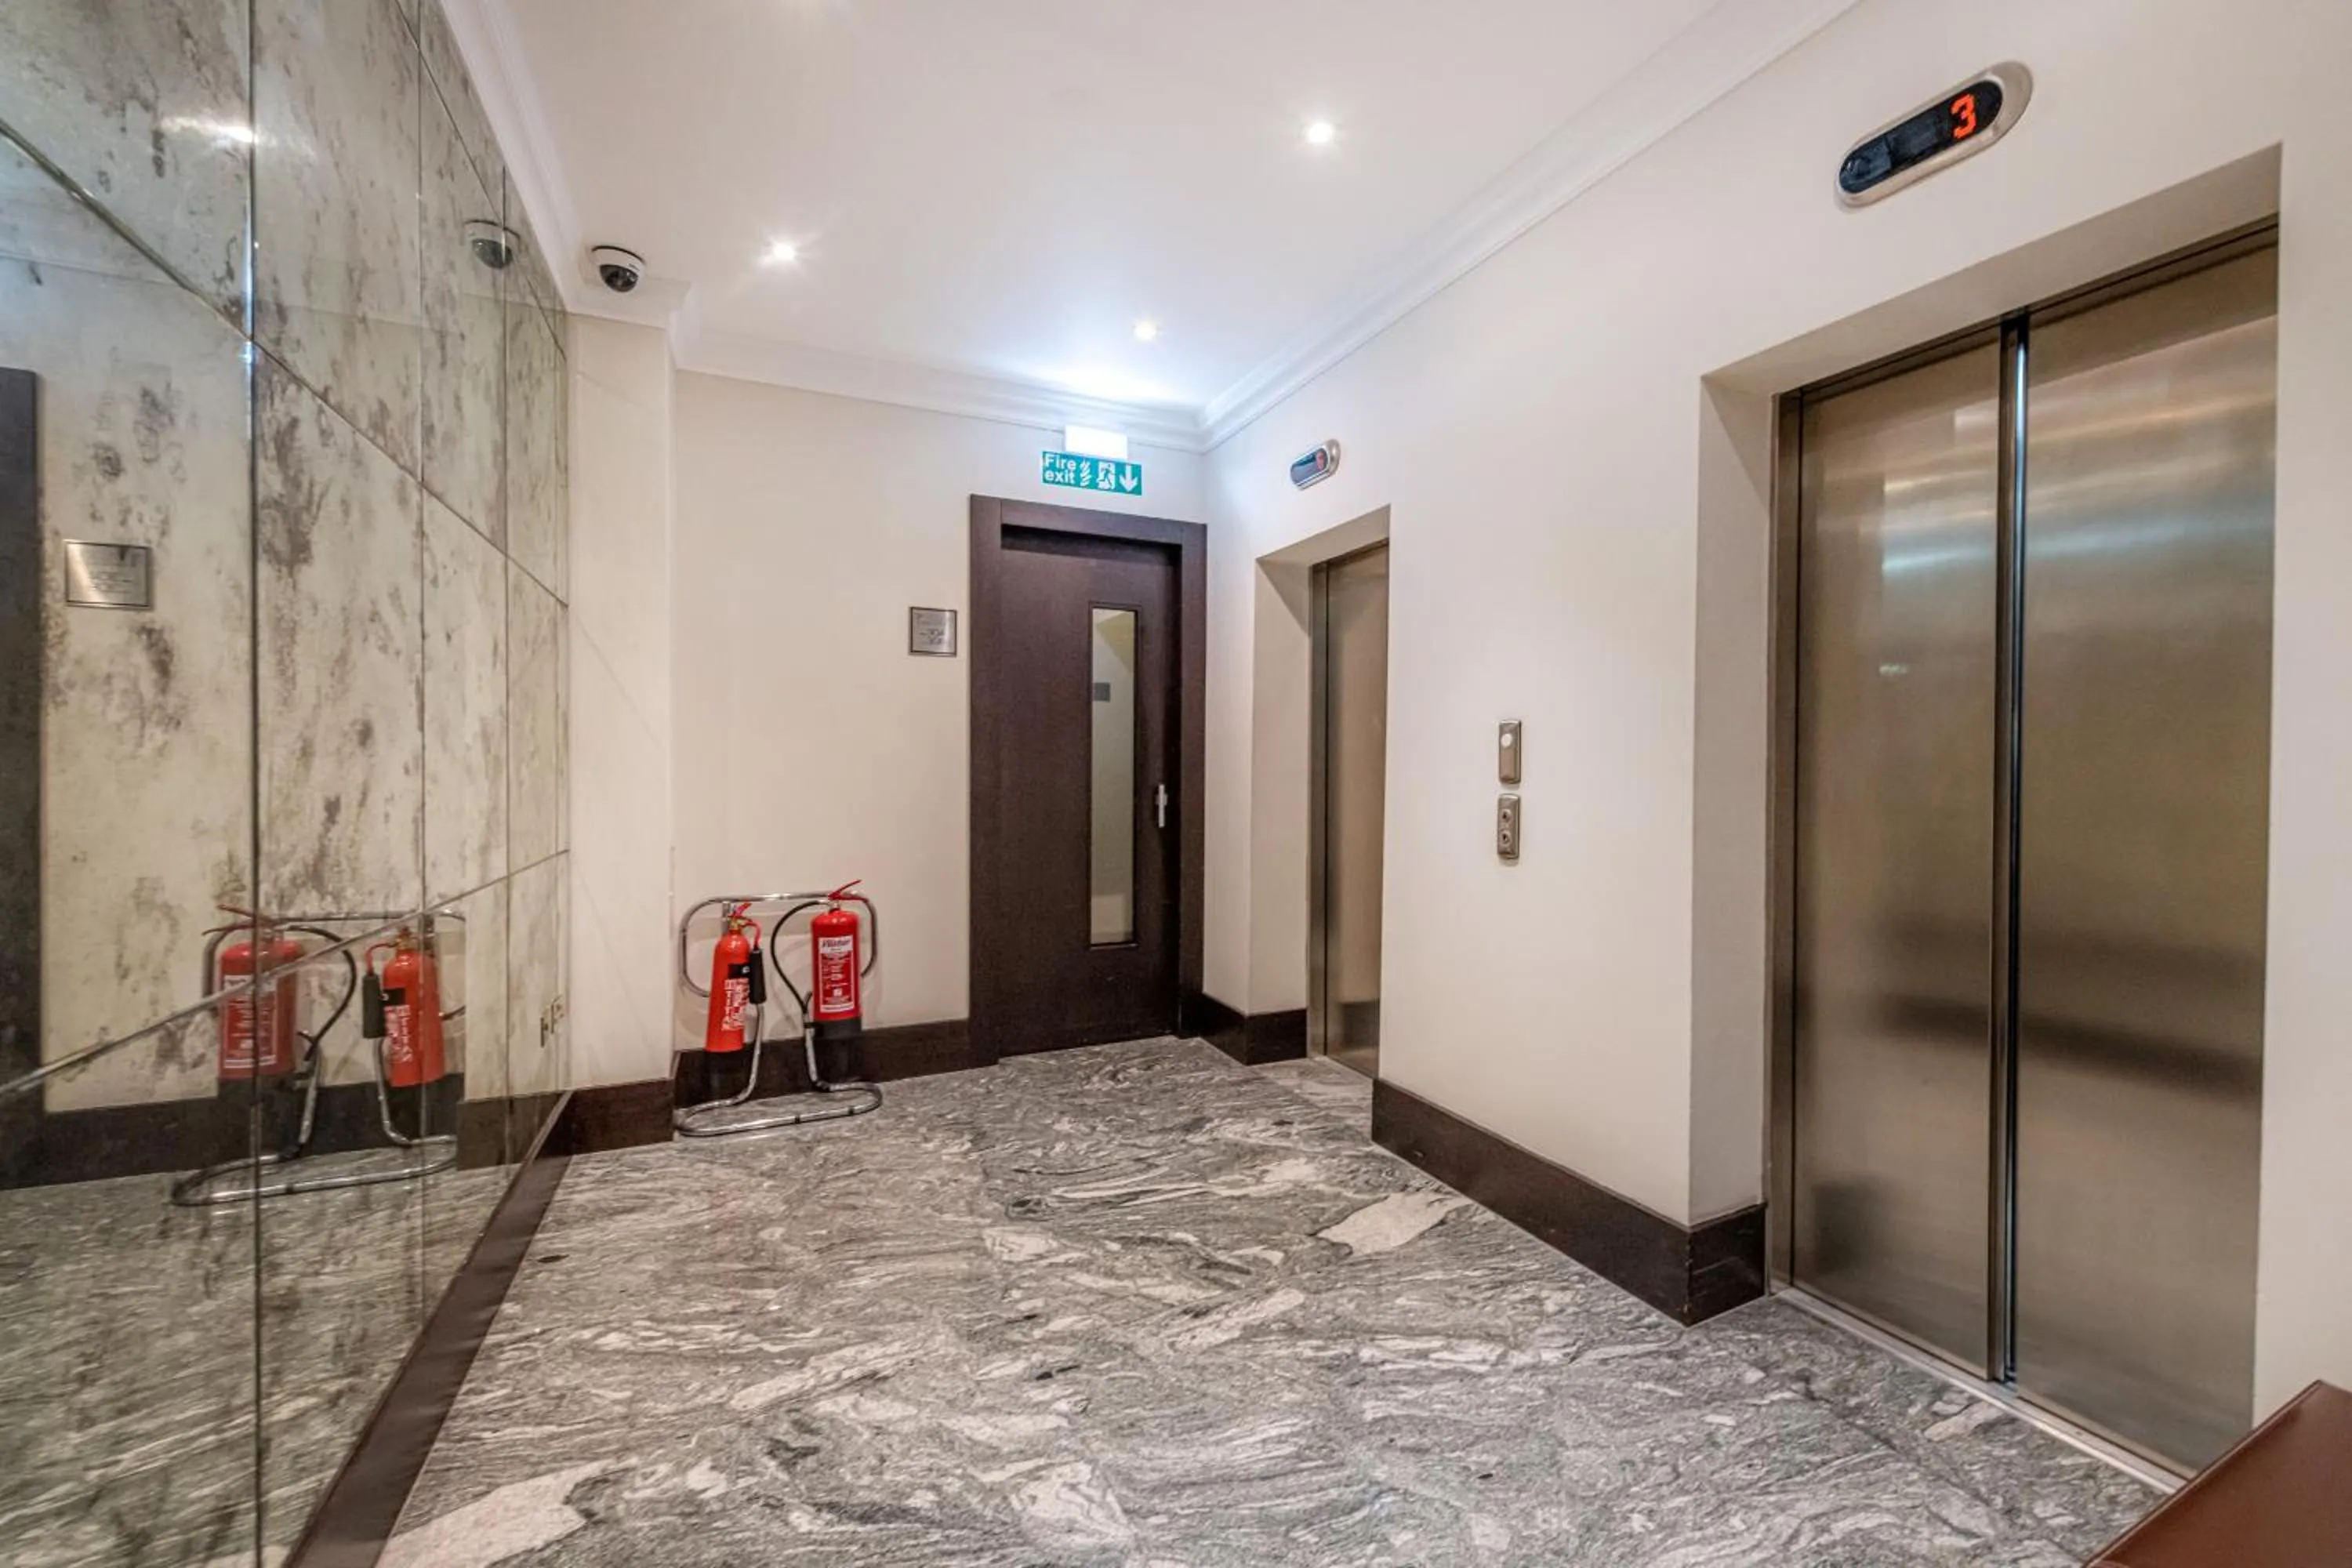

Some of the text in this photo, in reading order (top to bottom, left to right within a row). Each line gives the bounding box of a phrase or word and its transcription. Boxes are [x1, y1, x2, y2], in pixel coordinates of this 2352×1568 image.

[1951, 93, 1976, 139] 3
[1045, 453, 1076, 470] Fire
[1044, 470, 1076, 485] exit
